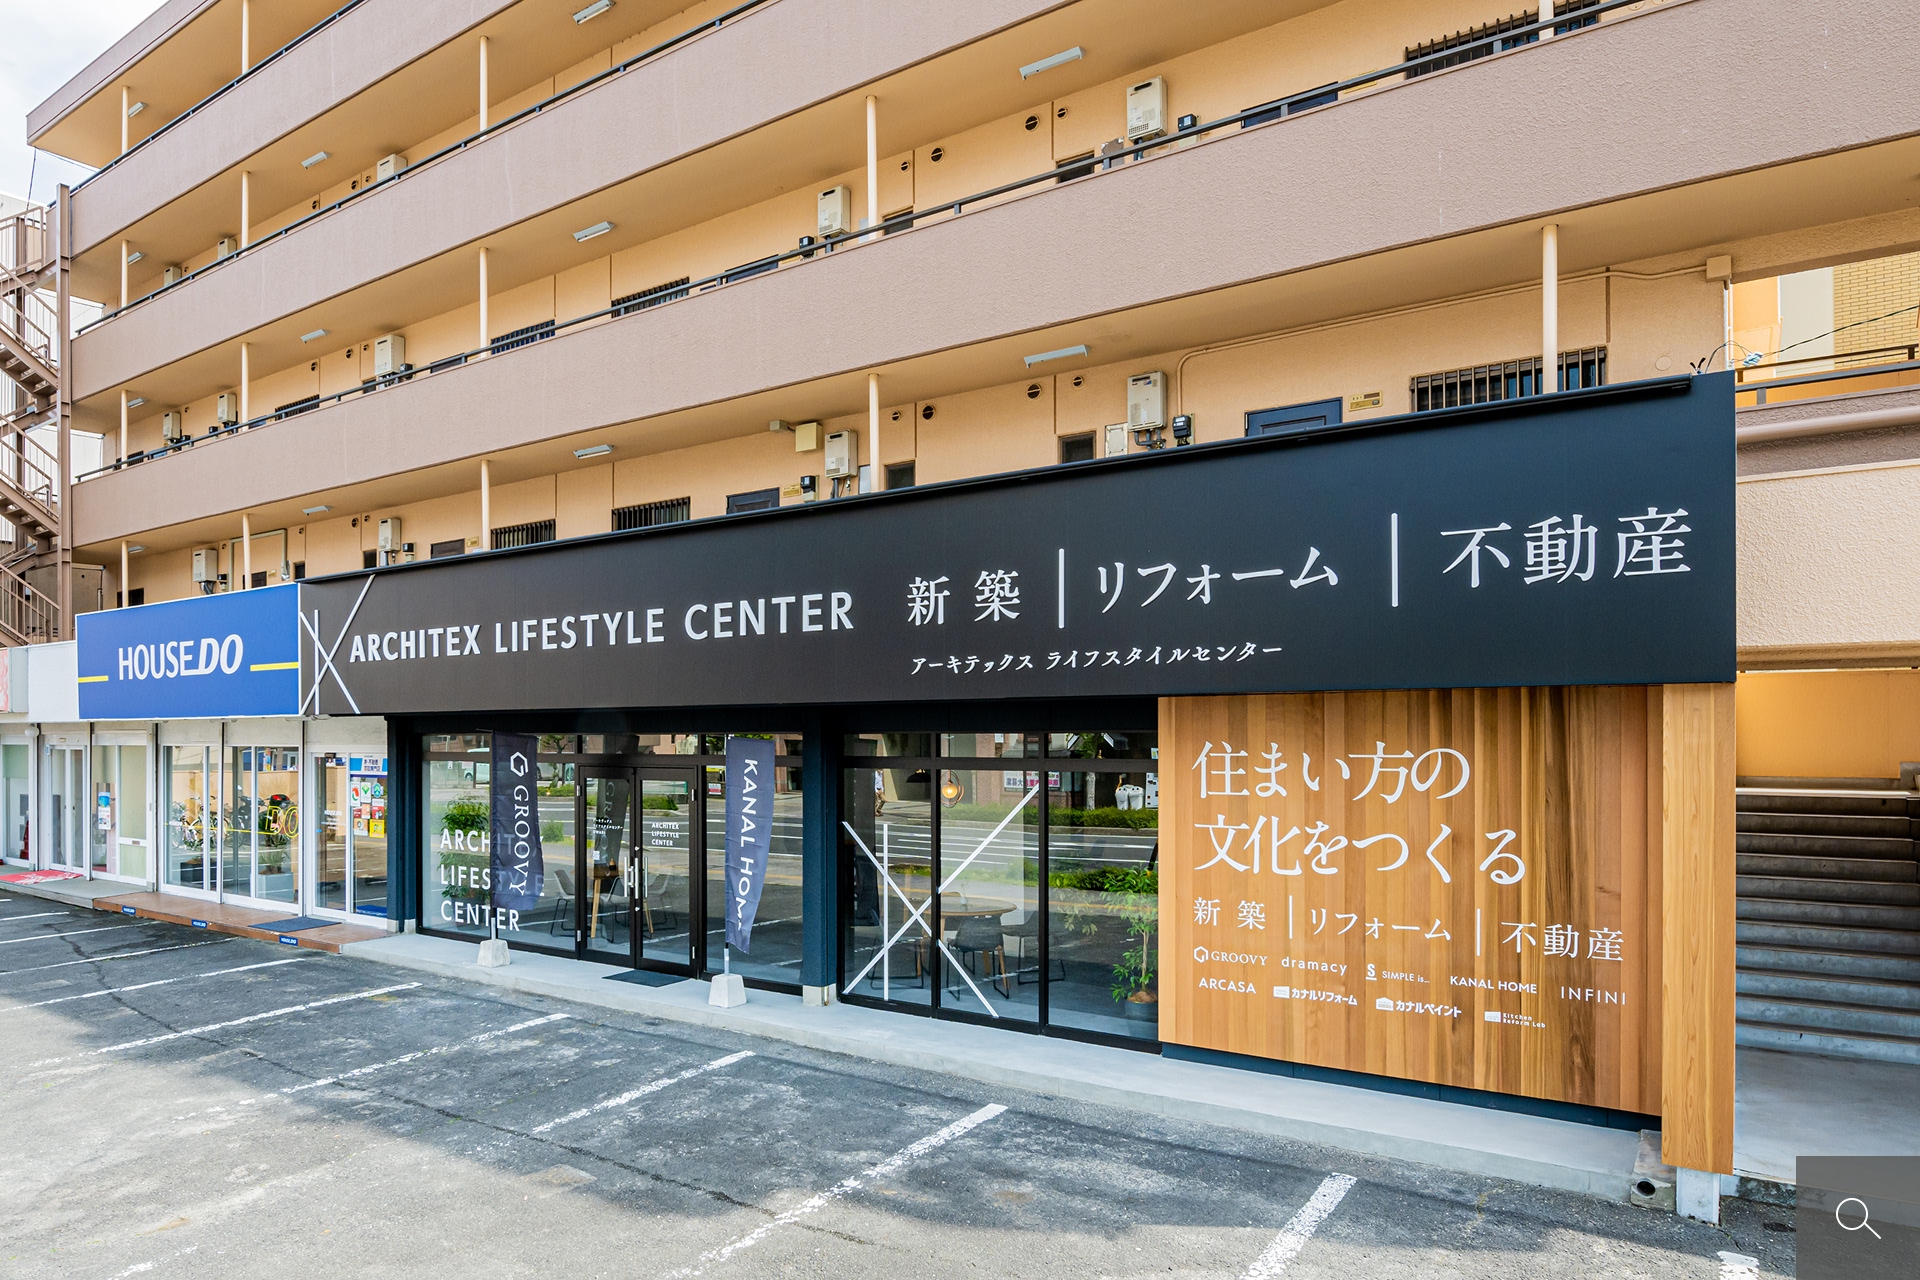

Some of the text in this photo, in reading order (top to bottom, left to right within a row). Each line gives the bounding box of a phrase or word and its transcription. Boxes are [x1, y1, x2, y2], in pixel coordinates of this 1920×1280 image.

[906, 506, 1692, 626] 新築 リフォーム 不動産
[349, 591, 854, 663] ARCHITEX LIFESTYLE CENTER
[911, 641, 1283, 675] アーキテックス ライフスタイルセンター
[1191, 741, 1470, 804] 住まい方の
[740, 758, 758, 848] KANAL
[651, 822, 680, 830] ARCHITEX
[508, 784, 531, 896] GROOVY
[651, 839, 674, 847] CENTER
[1193, 813, 1526, 885] 文化をつくる
[440, 899, 520, 931] CENTER
[1192, 896, 1624, 962] 新築 リフォーム 不動産
[1211, 951, 1268, 966] GROOVY
[1281, 956, 1347, 976] dramacy
[1198, 977, 1257, 994] ARCASA
[1382, 970, 1415, 982] SIMPLE
[1450, 975, 1537, 994] KANAL HOME
[1291, 987, 1358, 1006] カナルリフォーム
[1560, 986, 1626, 1005] INFINI
